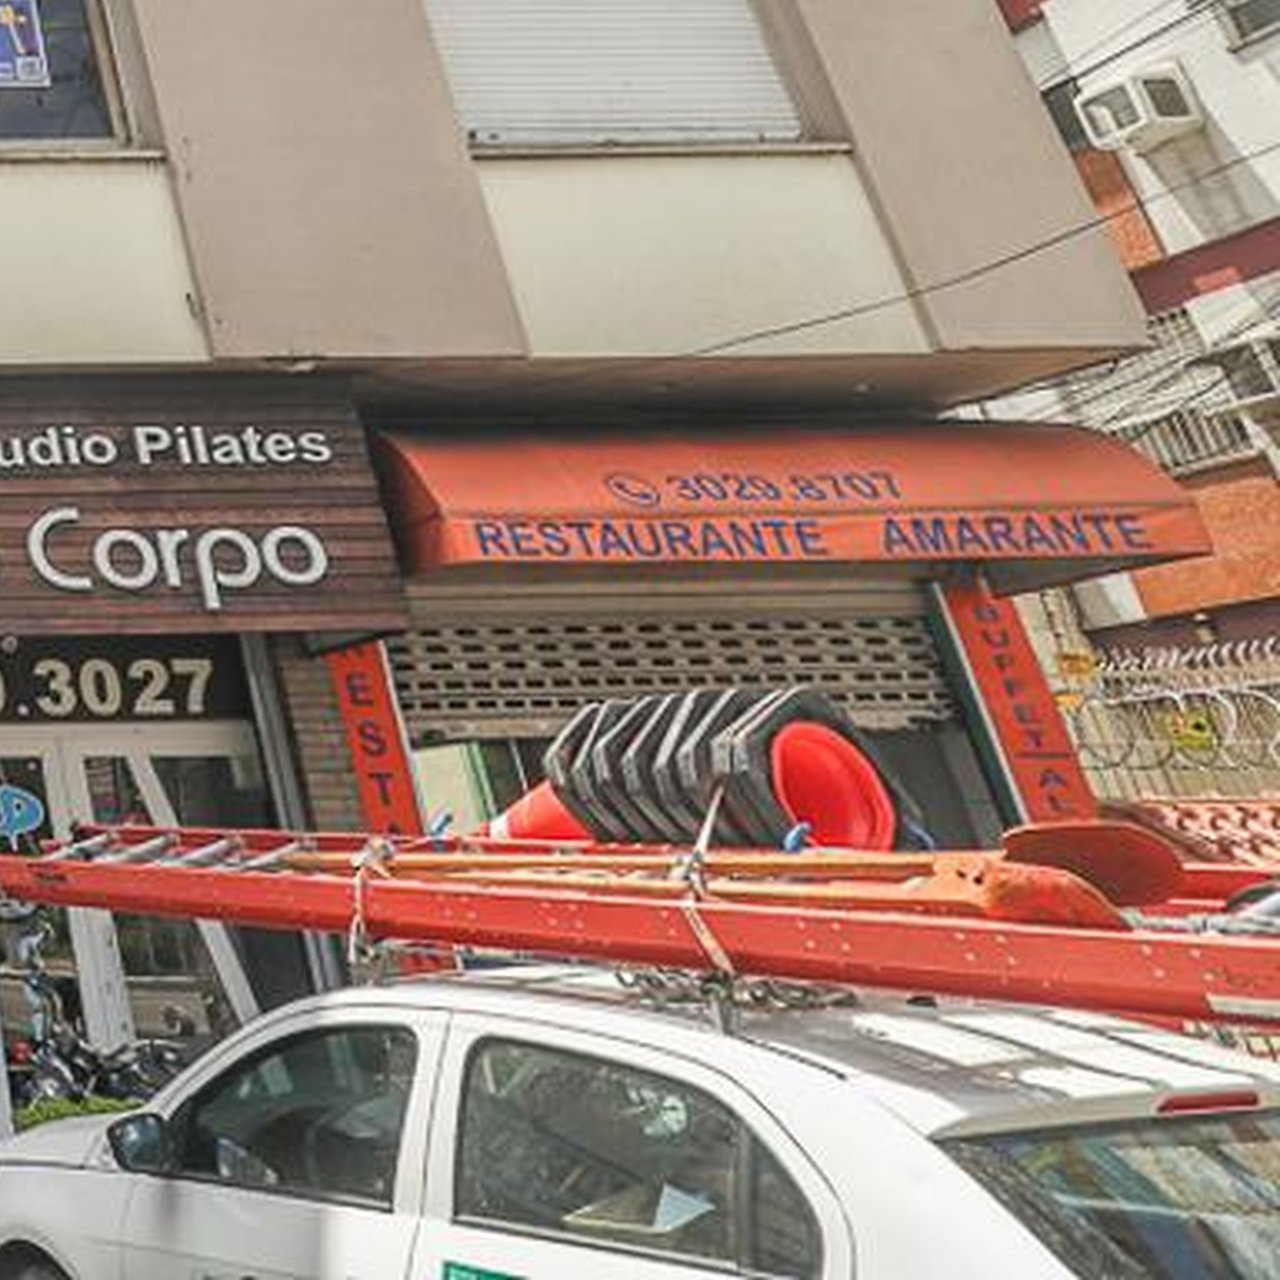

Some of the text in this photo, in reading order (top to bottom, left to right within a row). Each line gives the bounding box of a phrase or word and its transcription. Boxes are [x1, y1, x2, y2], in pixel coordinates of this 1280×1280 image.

[134, 425, 332, 466] Pilates
[27, 506, 328, 610] Corpo
[476, 510, 1155, 559] RESTAURANTE AMARANTE
